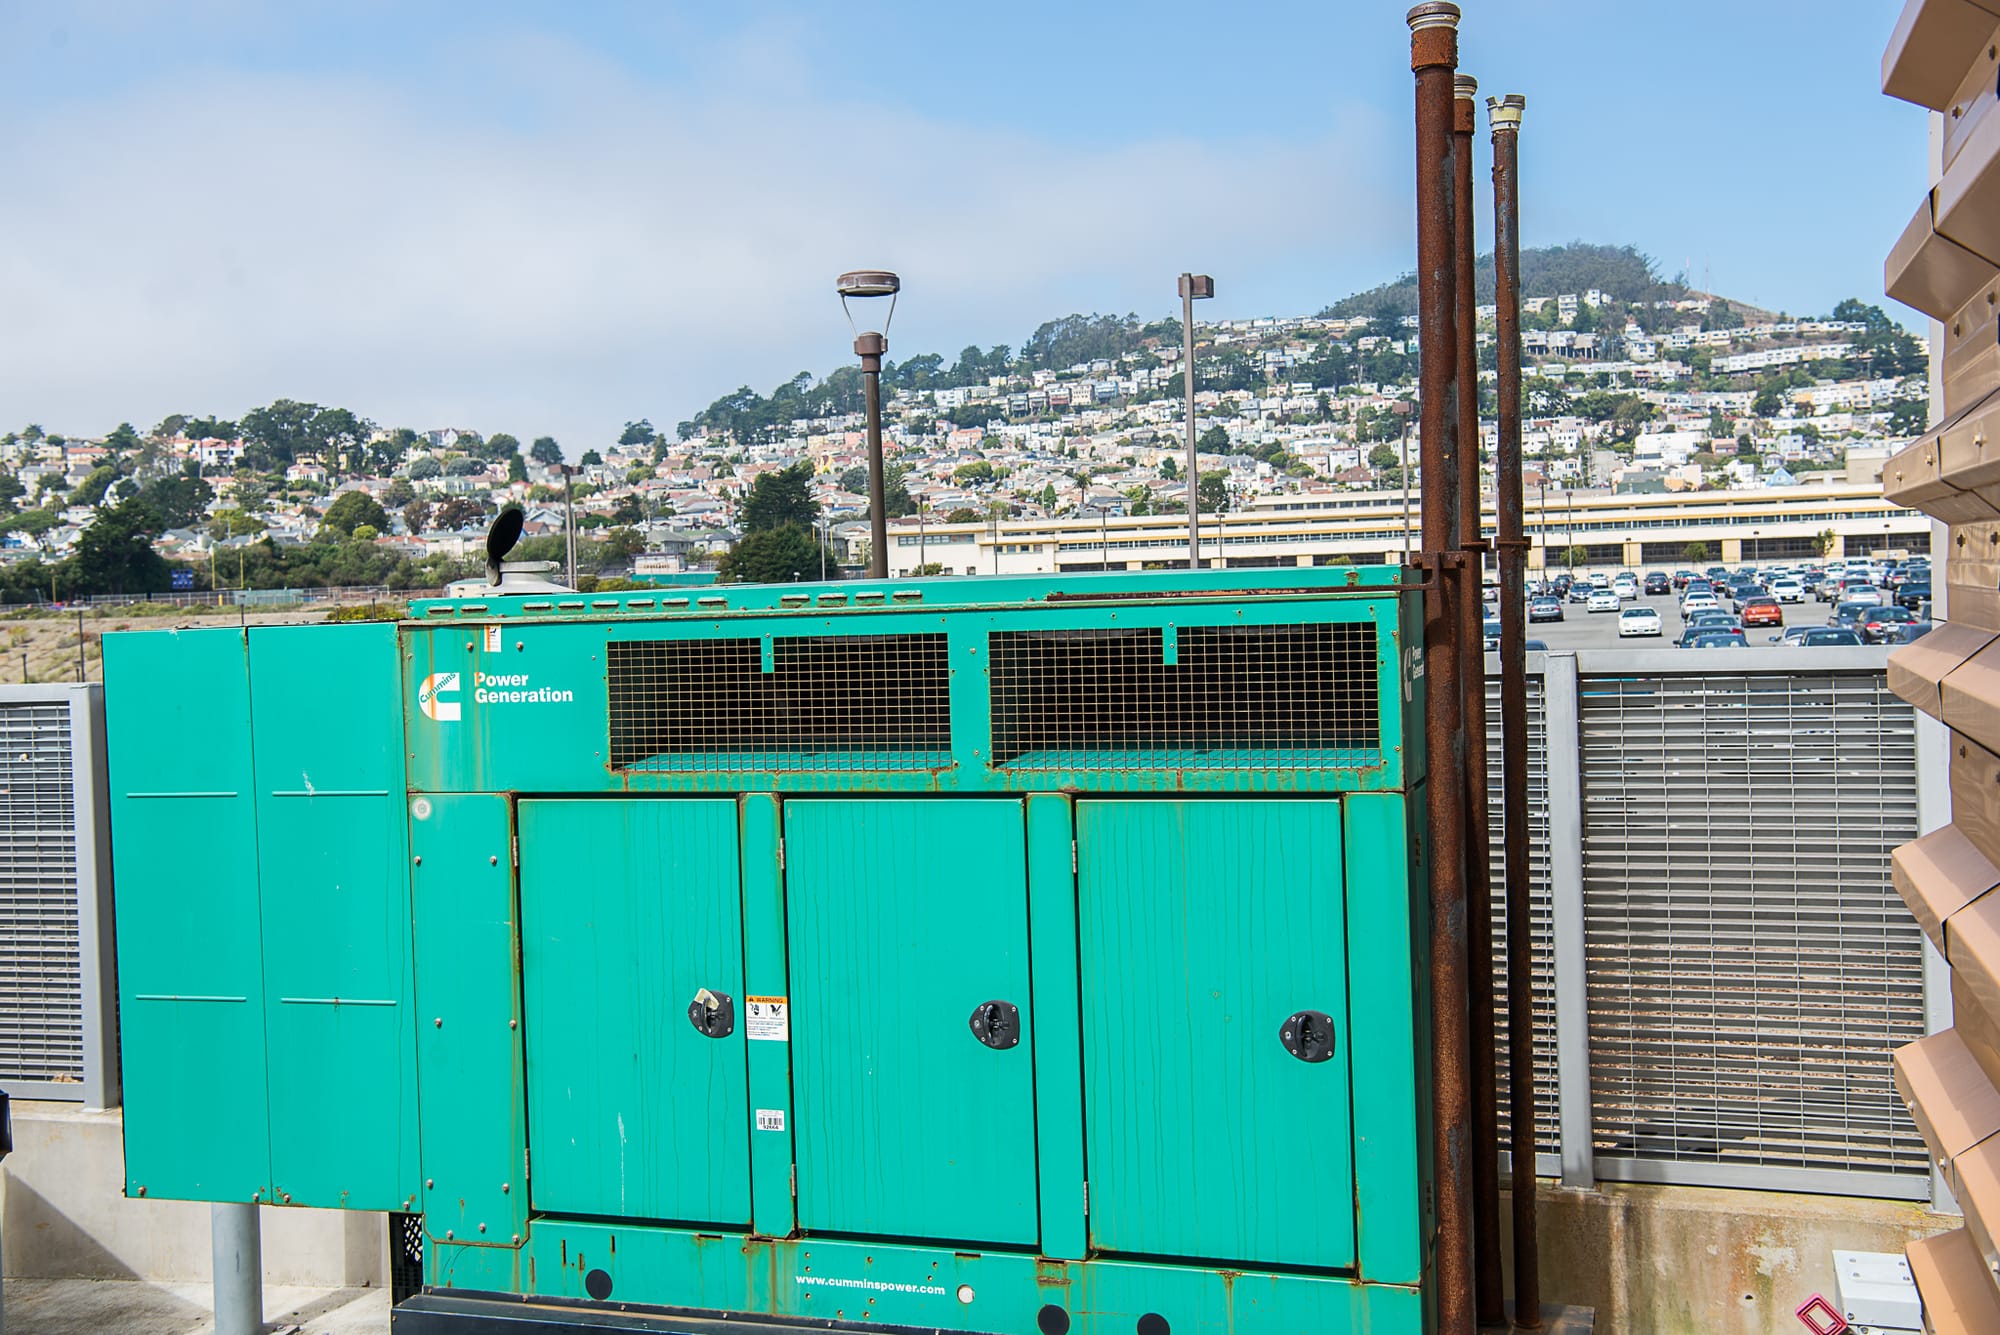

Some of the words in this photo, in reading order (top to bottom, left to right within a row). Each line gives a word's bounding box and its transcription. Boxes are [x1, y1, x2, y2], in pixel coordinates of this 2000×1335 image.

[420, 672, 456, 703] Cummins
[474, 672, 528, 687] Power
[474, 687, 573, 704] Generation
[795, 1275, 945, 1295] www.cumminspower.com
